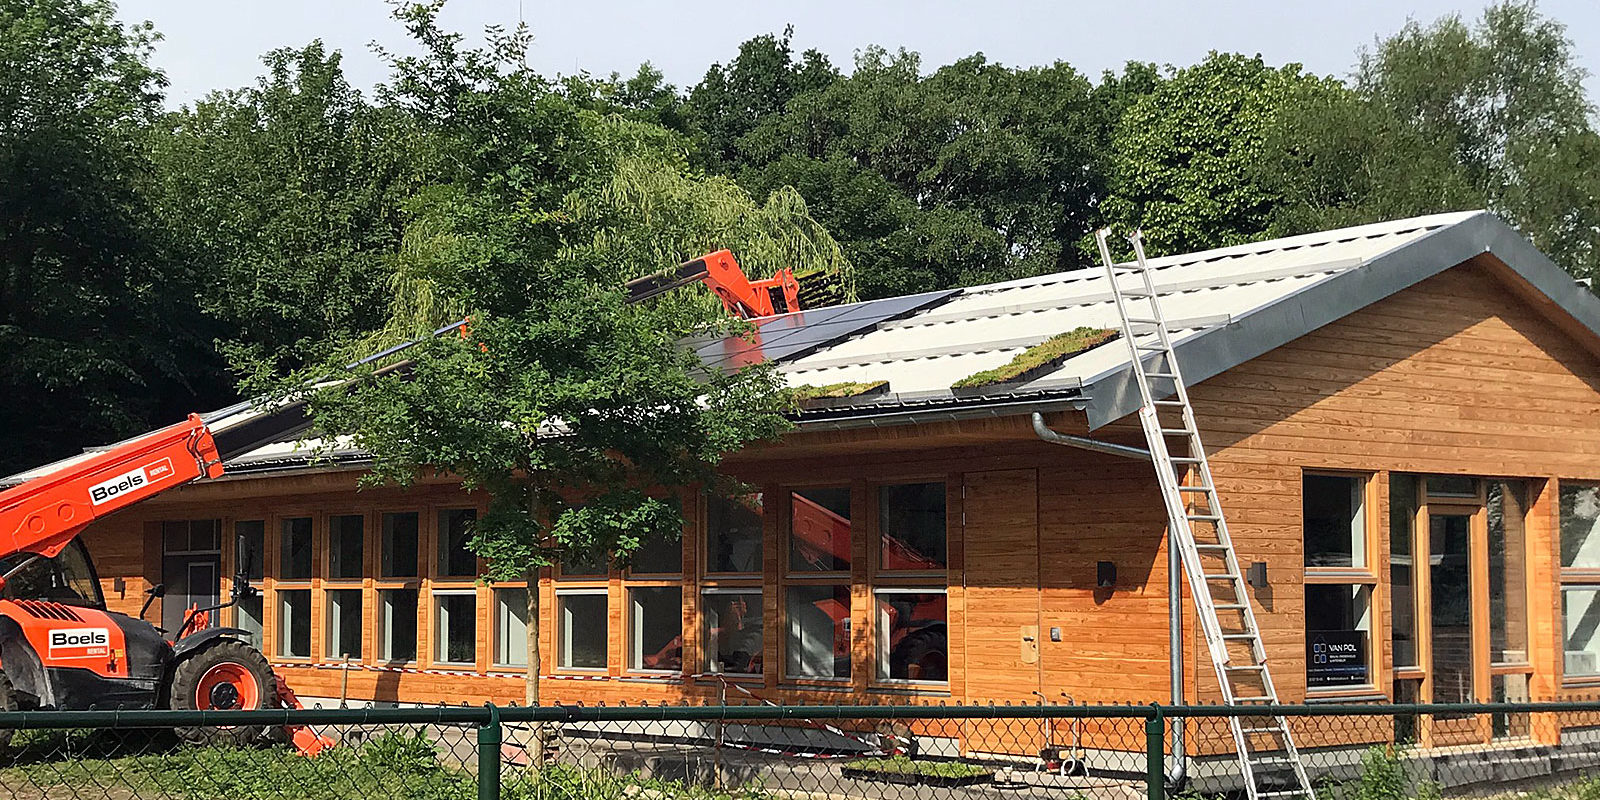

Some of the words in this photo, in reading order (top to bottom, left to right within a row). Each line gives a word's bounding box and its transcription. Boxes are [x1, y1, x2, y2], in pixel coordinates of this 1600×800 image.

[92, 476, 143, 501] Boels
[149, 465, 169, 477] RENTAL
[53, 632, 105, 645] Boels
